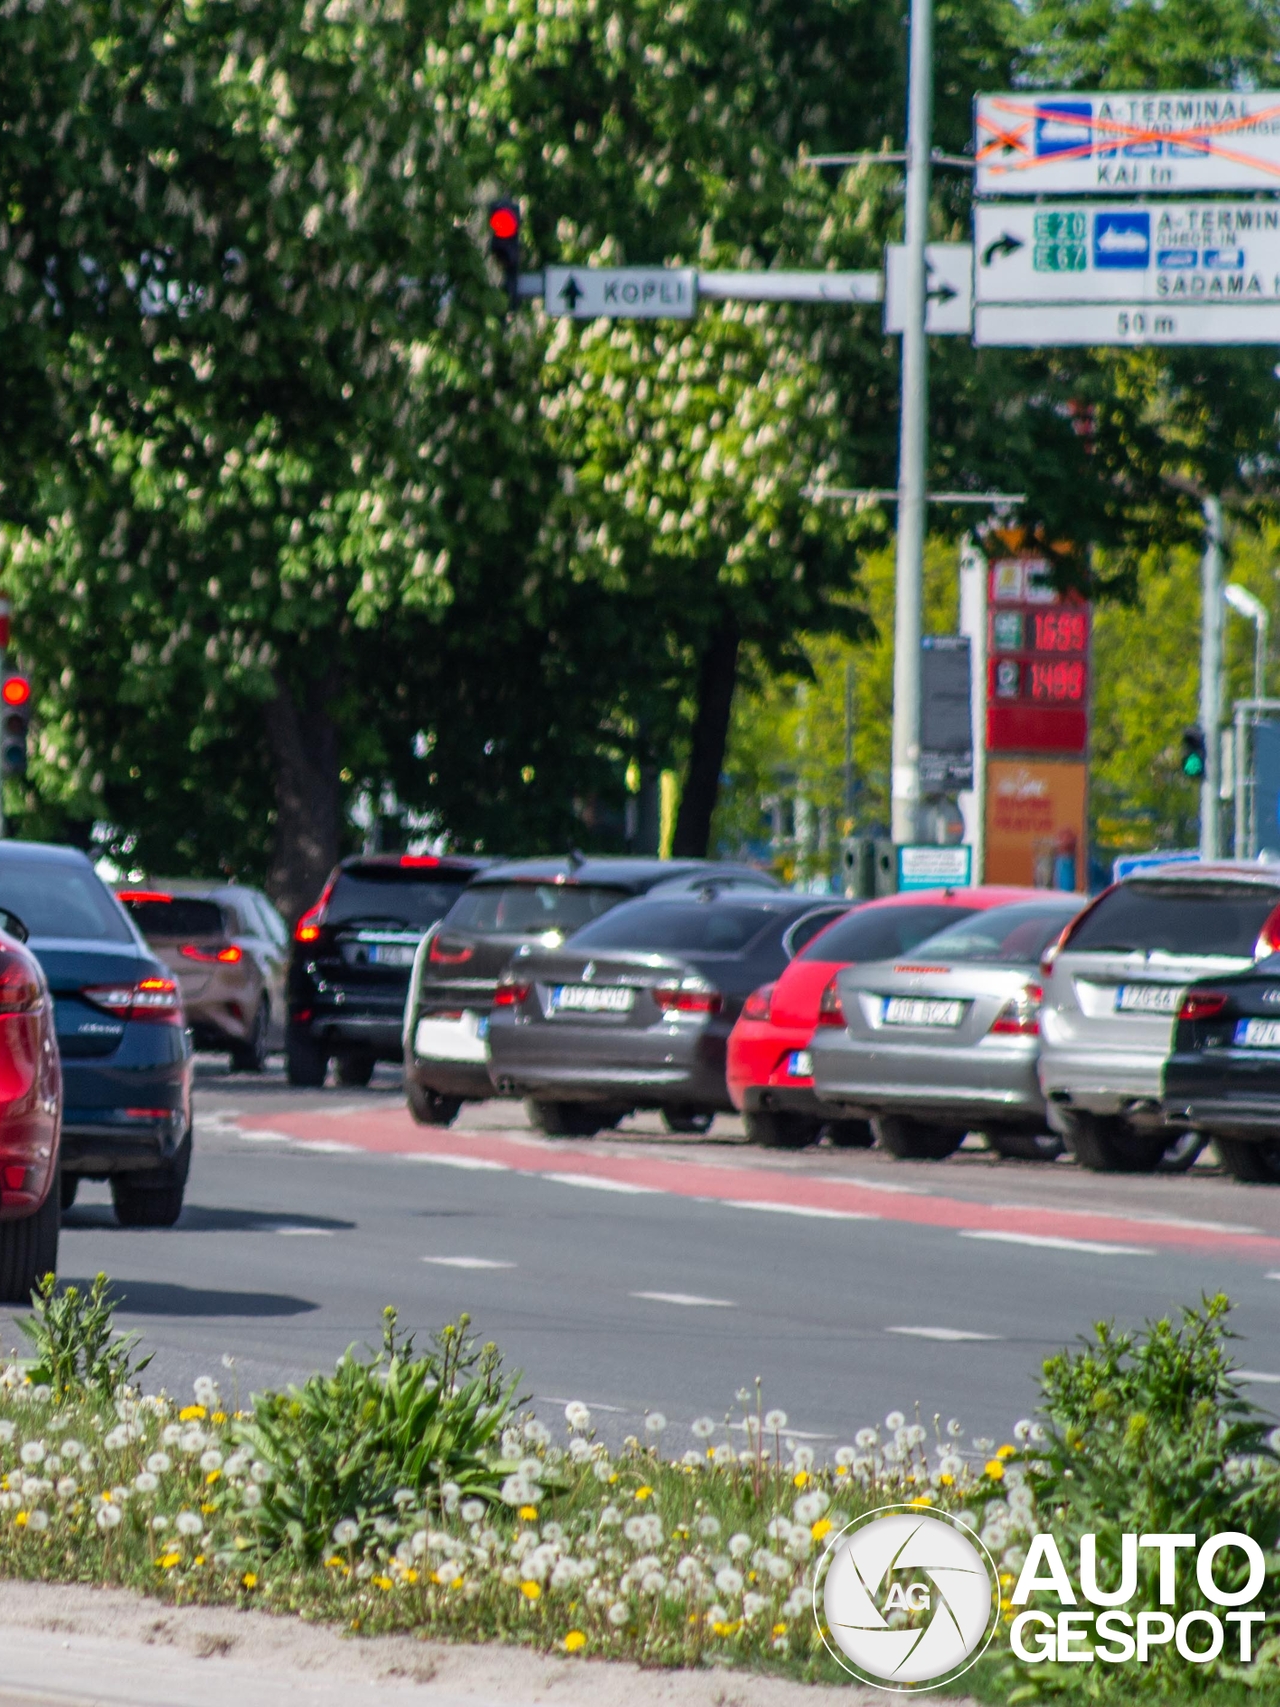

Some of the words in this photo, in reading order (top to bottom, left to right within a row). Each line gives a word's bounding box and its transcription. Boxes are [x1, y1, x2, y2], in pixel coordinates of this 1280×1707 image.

[1057, 214, 1084, 238] 20
[1057, 246, 1084, 269] 67
[604, 280, 683, 304] KOPLI
[1156, 275, 1262, 296] SADAMA
[1117, 312, 1145, 335] 50
[1154, 316, 1175, 334] m
